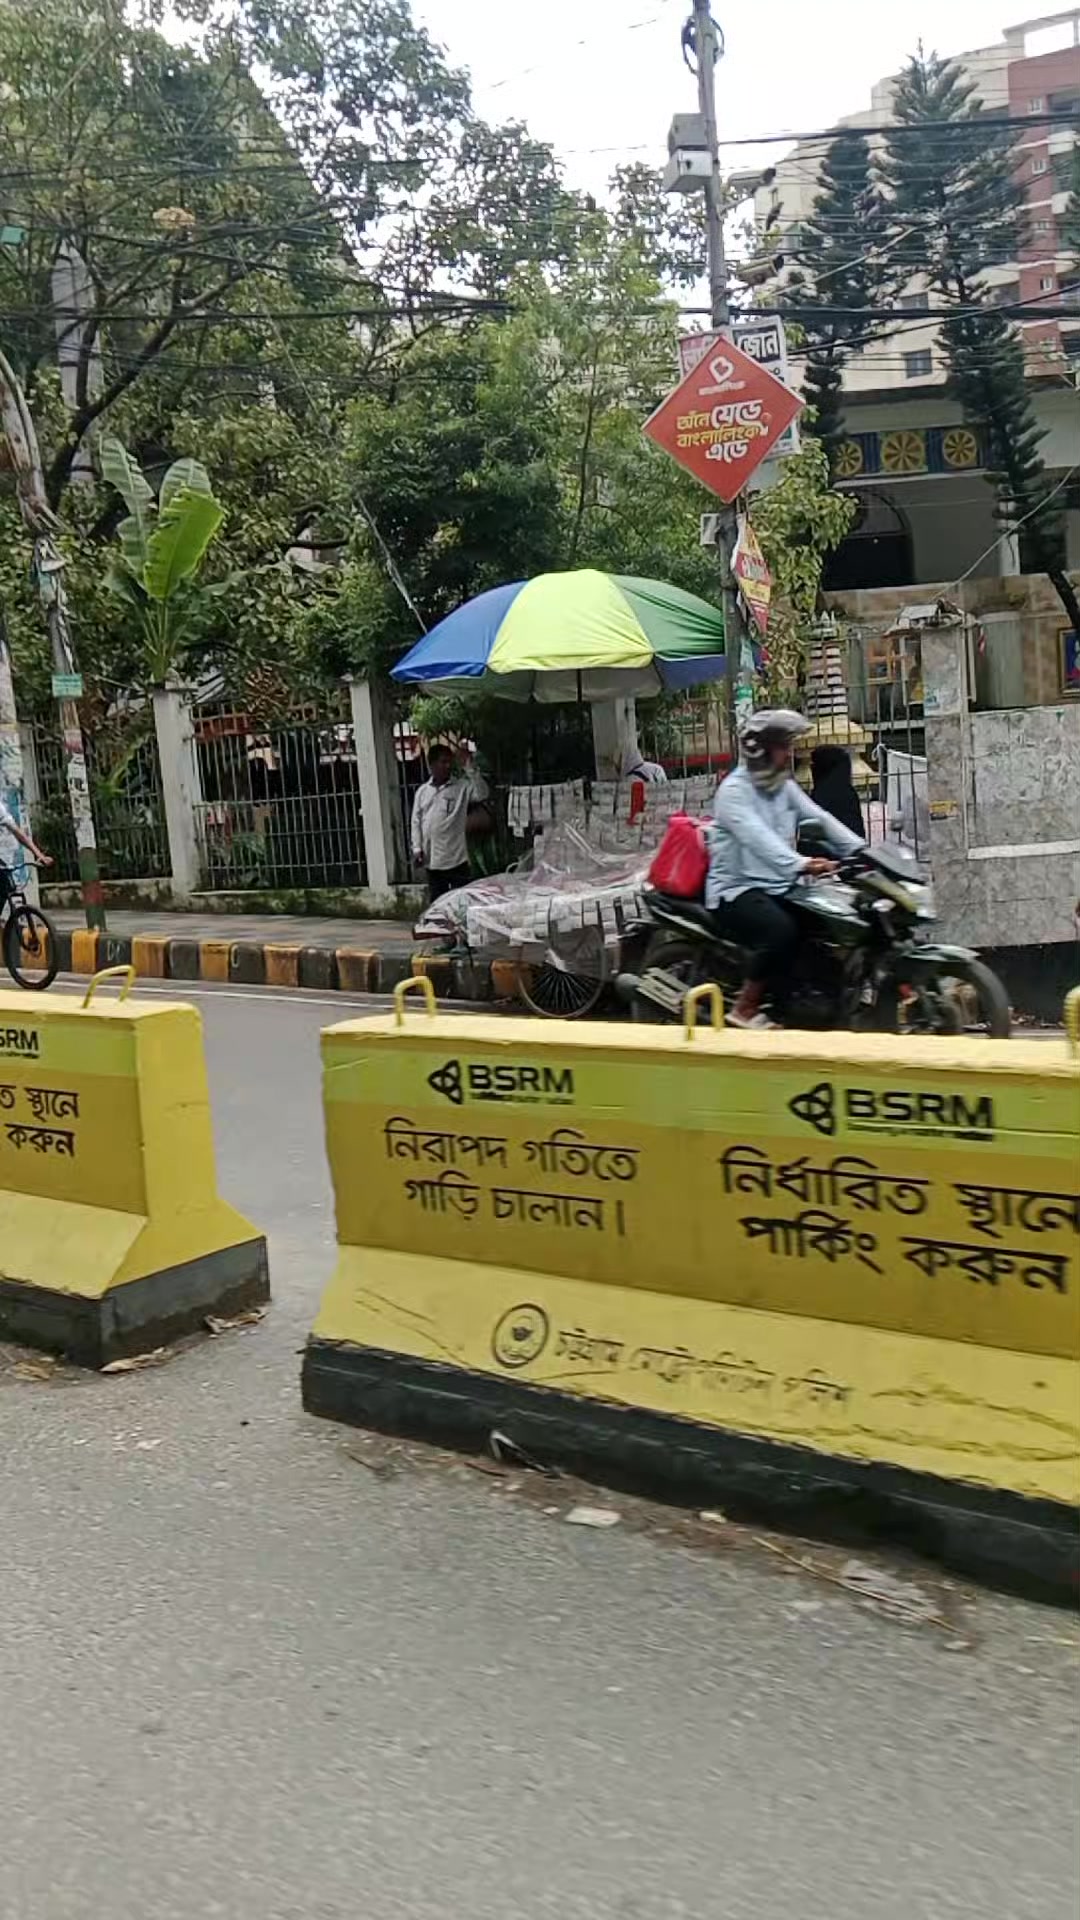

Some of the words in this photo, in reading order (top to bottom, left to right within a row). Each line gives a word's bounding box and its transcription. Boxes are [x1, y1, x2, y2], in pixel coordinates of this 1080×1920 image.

[468, 1065, 575, 1094] BSRM
[23, 1087, 80, 1122] স্থানে
[844, 1088, 994, 1130] BSRM
[4, 1123, 76, 1157] করুন
[384, 1117, 508, 1169] নিরাপদ
[522, 1128, 641, 1181] গতিতে
[404, 1169, 481, 1221] গাড়ি
[719, 1145, 934, 1216] নির্ধারিত
[738, 1209, 886, 1275] পার্কিং
[897, 1236, 1071, 1294] করুন
